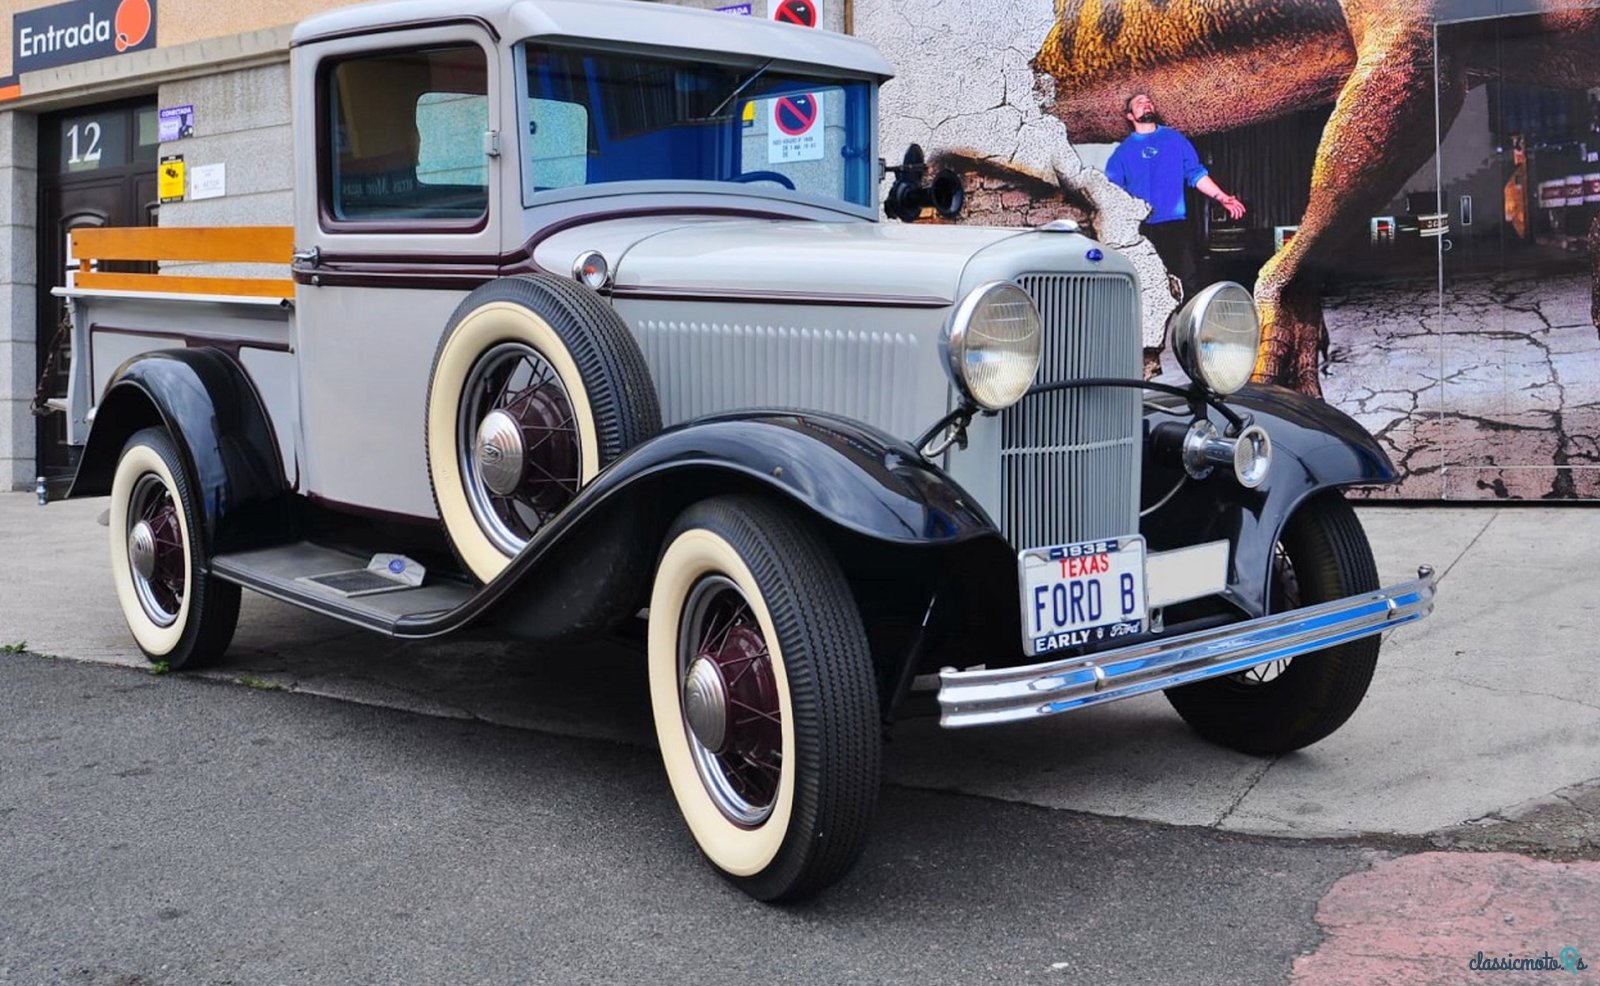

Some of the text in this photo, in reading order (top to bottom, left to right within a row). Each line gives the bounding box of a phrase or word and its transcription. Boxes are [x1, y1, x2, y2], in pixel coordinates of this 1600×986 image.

[20, 12, 110, 58] Entrada
[67, 121, 102, 165] 12
[1059, 553, 1109, 579] TEXAS
[1035, 572, 1135, 632] FORD B
[1036, 629, 1091, 653] EARLY
[1110, 621, 1140, 638] Ford
